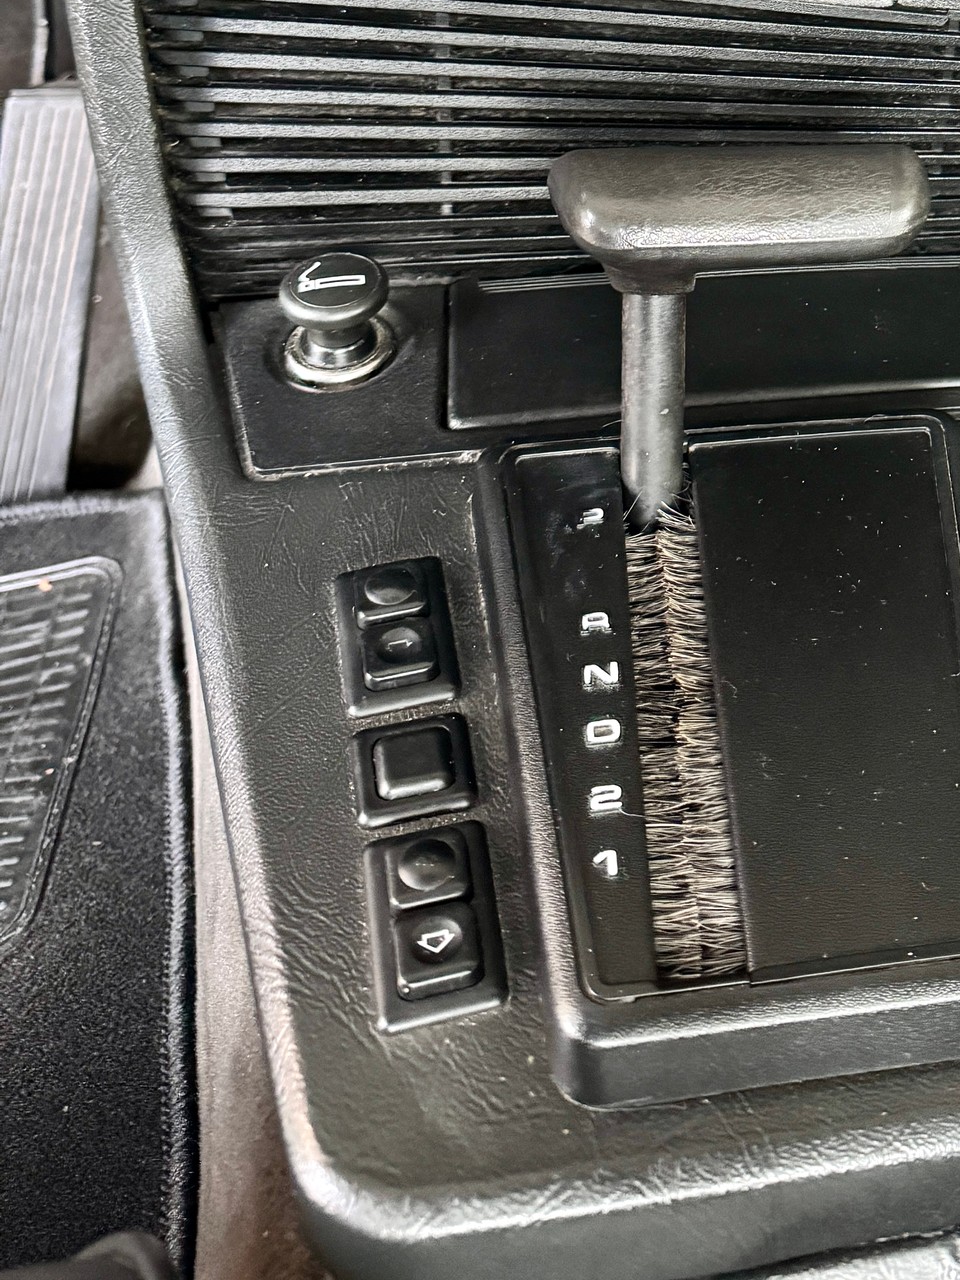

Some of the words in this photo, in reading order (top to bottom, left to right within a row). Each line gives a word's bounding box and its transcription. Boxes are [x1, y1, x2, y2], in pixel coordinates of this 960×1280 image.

[584, 661, 619, 687] N
[585, 718, 621, 744] D
[589, 784, 623, 812] 2
[592, 850, 619, 876] 1
